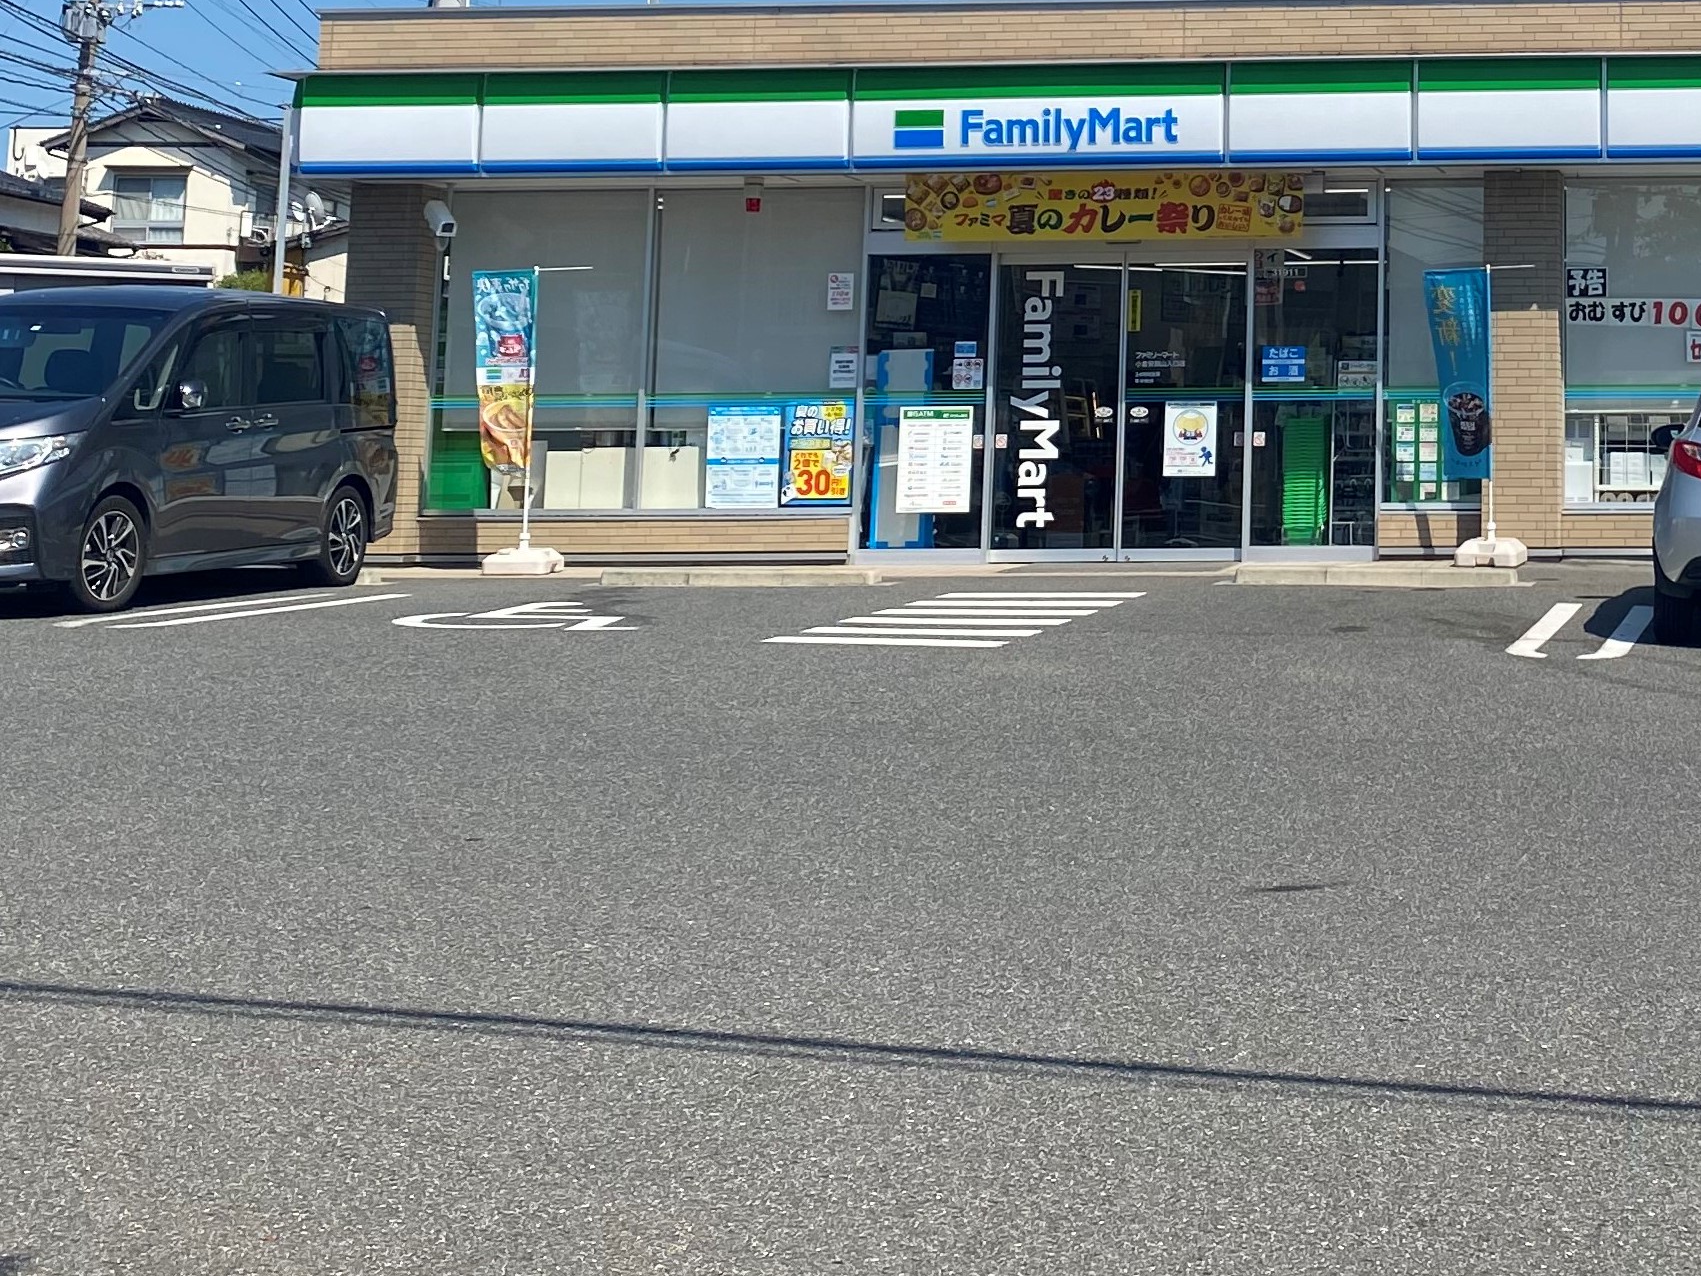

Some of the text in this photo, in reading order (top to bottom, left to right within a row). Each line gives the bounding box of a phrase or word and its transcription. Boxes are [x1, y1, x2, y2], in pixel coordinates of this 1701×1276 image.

[961, 108, 1178, 152] FamilyMart
[1569, 269, 1604, 296] 予告
[1269, 348, 1298, 359] たばこ
[1010, 271, 1065, 528] FamilyMart
[791, 418, 852, 435] お買い得!
[796, 469, 831, 495] 30
